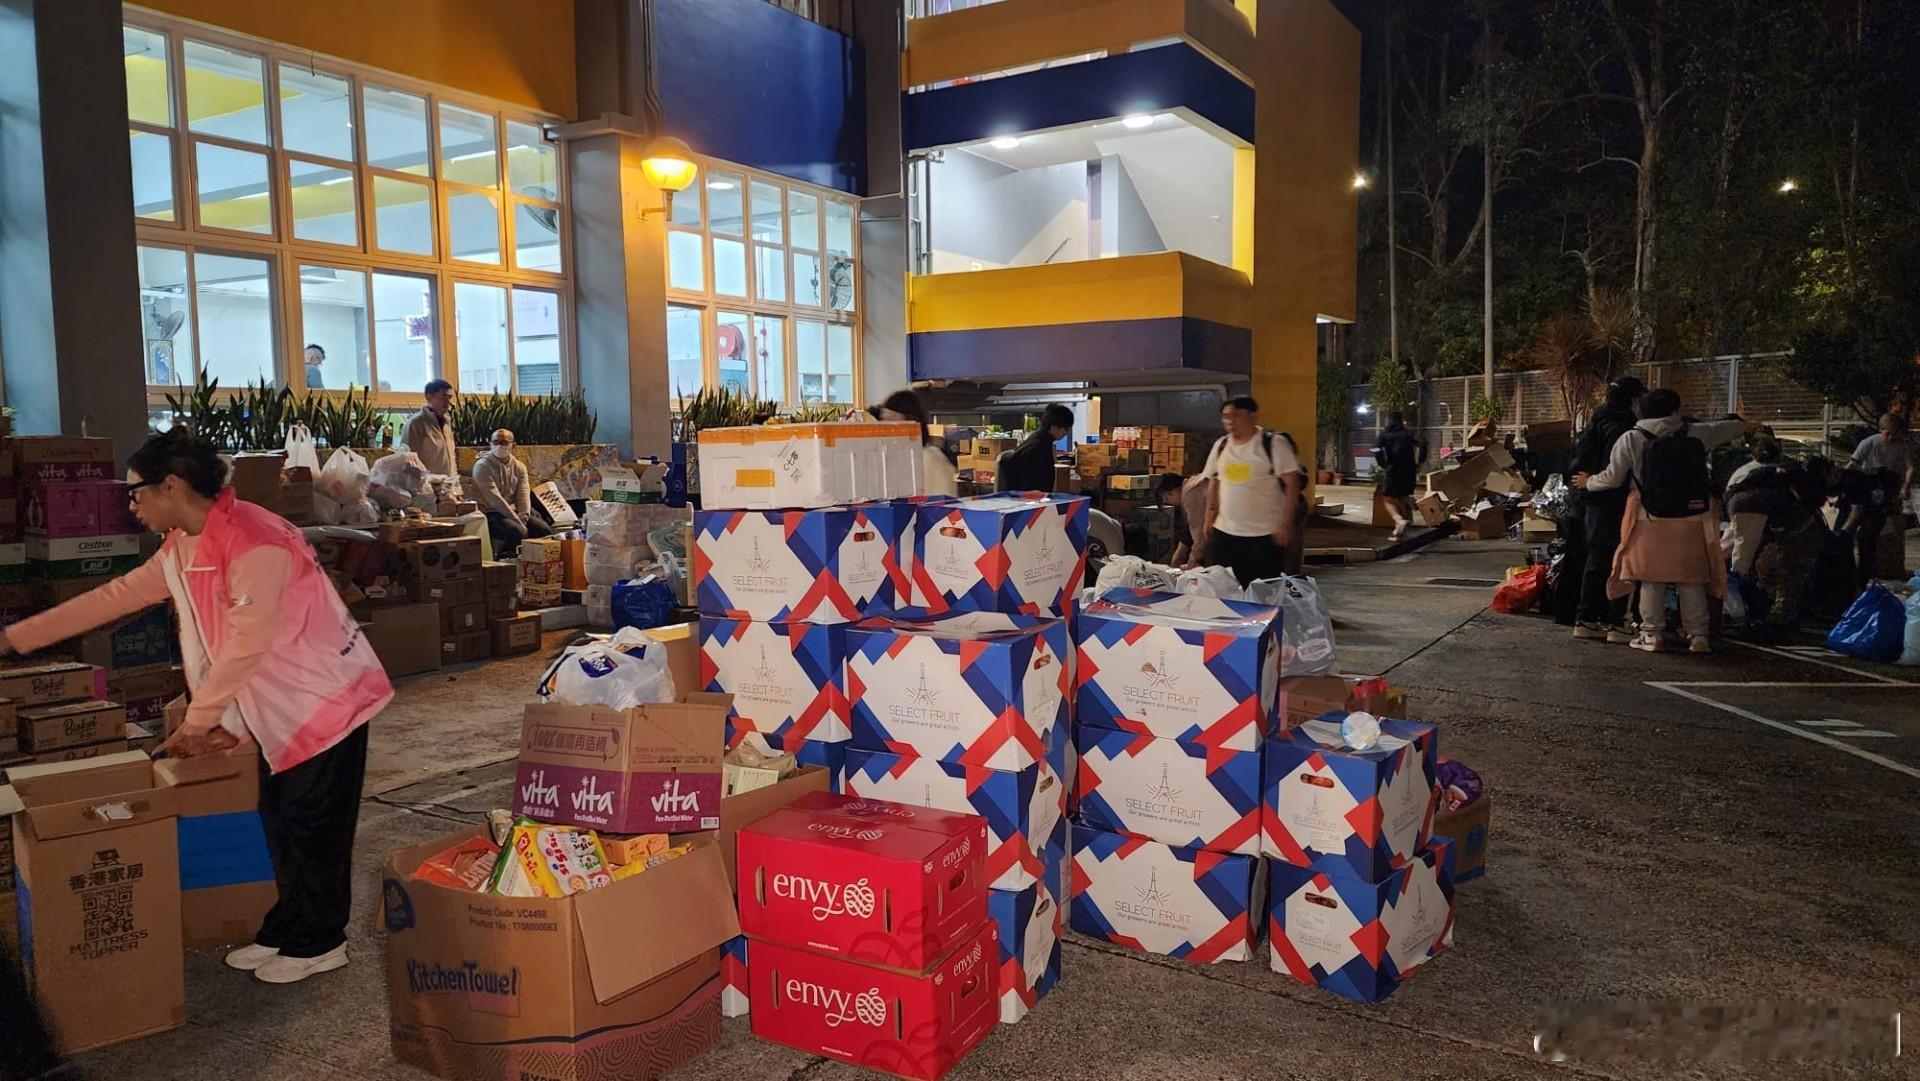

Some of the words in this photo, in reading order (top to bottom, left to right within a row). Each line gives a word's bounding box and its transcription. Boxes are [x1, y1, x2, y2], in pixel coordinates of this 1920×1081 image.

[732, 575, 763, 586] SELECT
[764, 576, 792, 588] FRUIT
[737, 682, 768, 696] SELECT
[770, 685, 795, 698] FRUIT
[1122, 685, 1165, 702] SELECT
[1167, 692, 1201, 706] FRUIT
[888, 704, 927, 719] SELECT
[929, 709, 960, 723] FRUIT
[522, 769, 560, 808] vita
[571, 775, 614, 815] vita
[651, 779, 700, 813] vita
[1125, 798, 1167, 813] SELECT
[1170, 805, 1204, 820] FRUIT
[807, 823, 857, 839] envy
[942, 843, 965, 869] envy
[69, 862, 143, 891] 香港家居
[773, 873, 845, 921] envy
[468, 904, 492, 917] Product
[1114, 900, 1155, 917] SELECT
[1159, 909, 1192, 924] FRUIT
[69, 929, 148, 955] MATTRESS
[81, 941, 138, 960] TOPPER
[953, 953, 976, 976] envy
[406, 959, 518, 996] KitchenTowel
[786, 979, 857, 1028] envy
